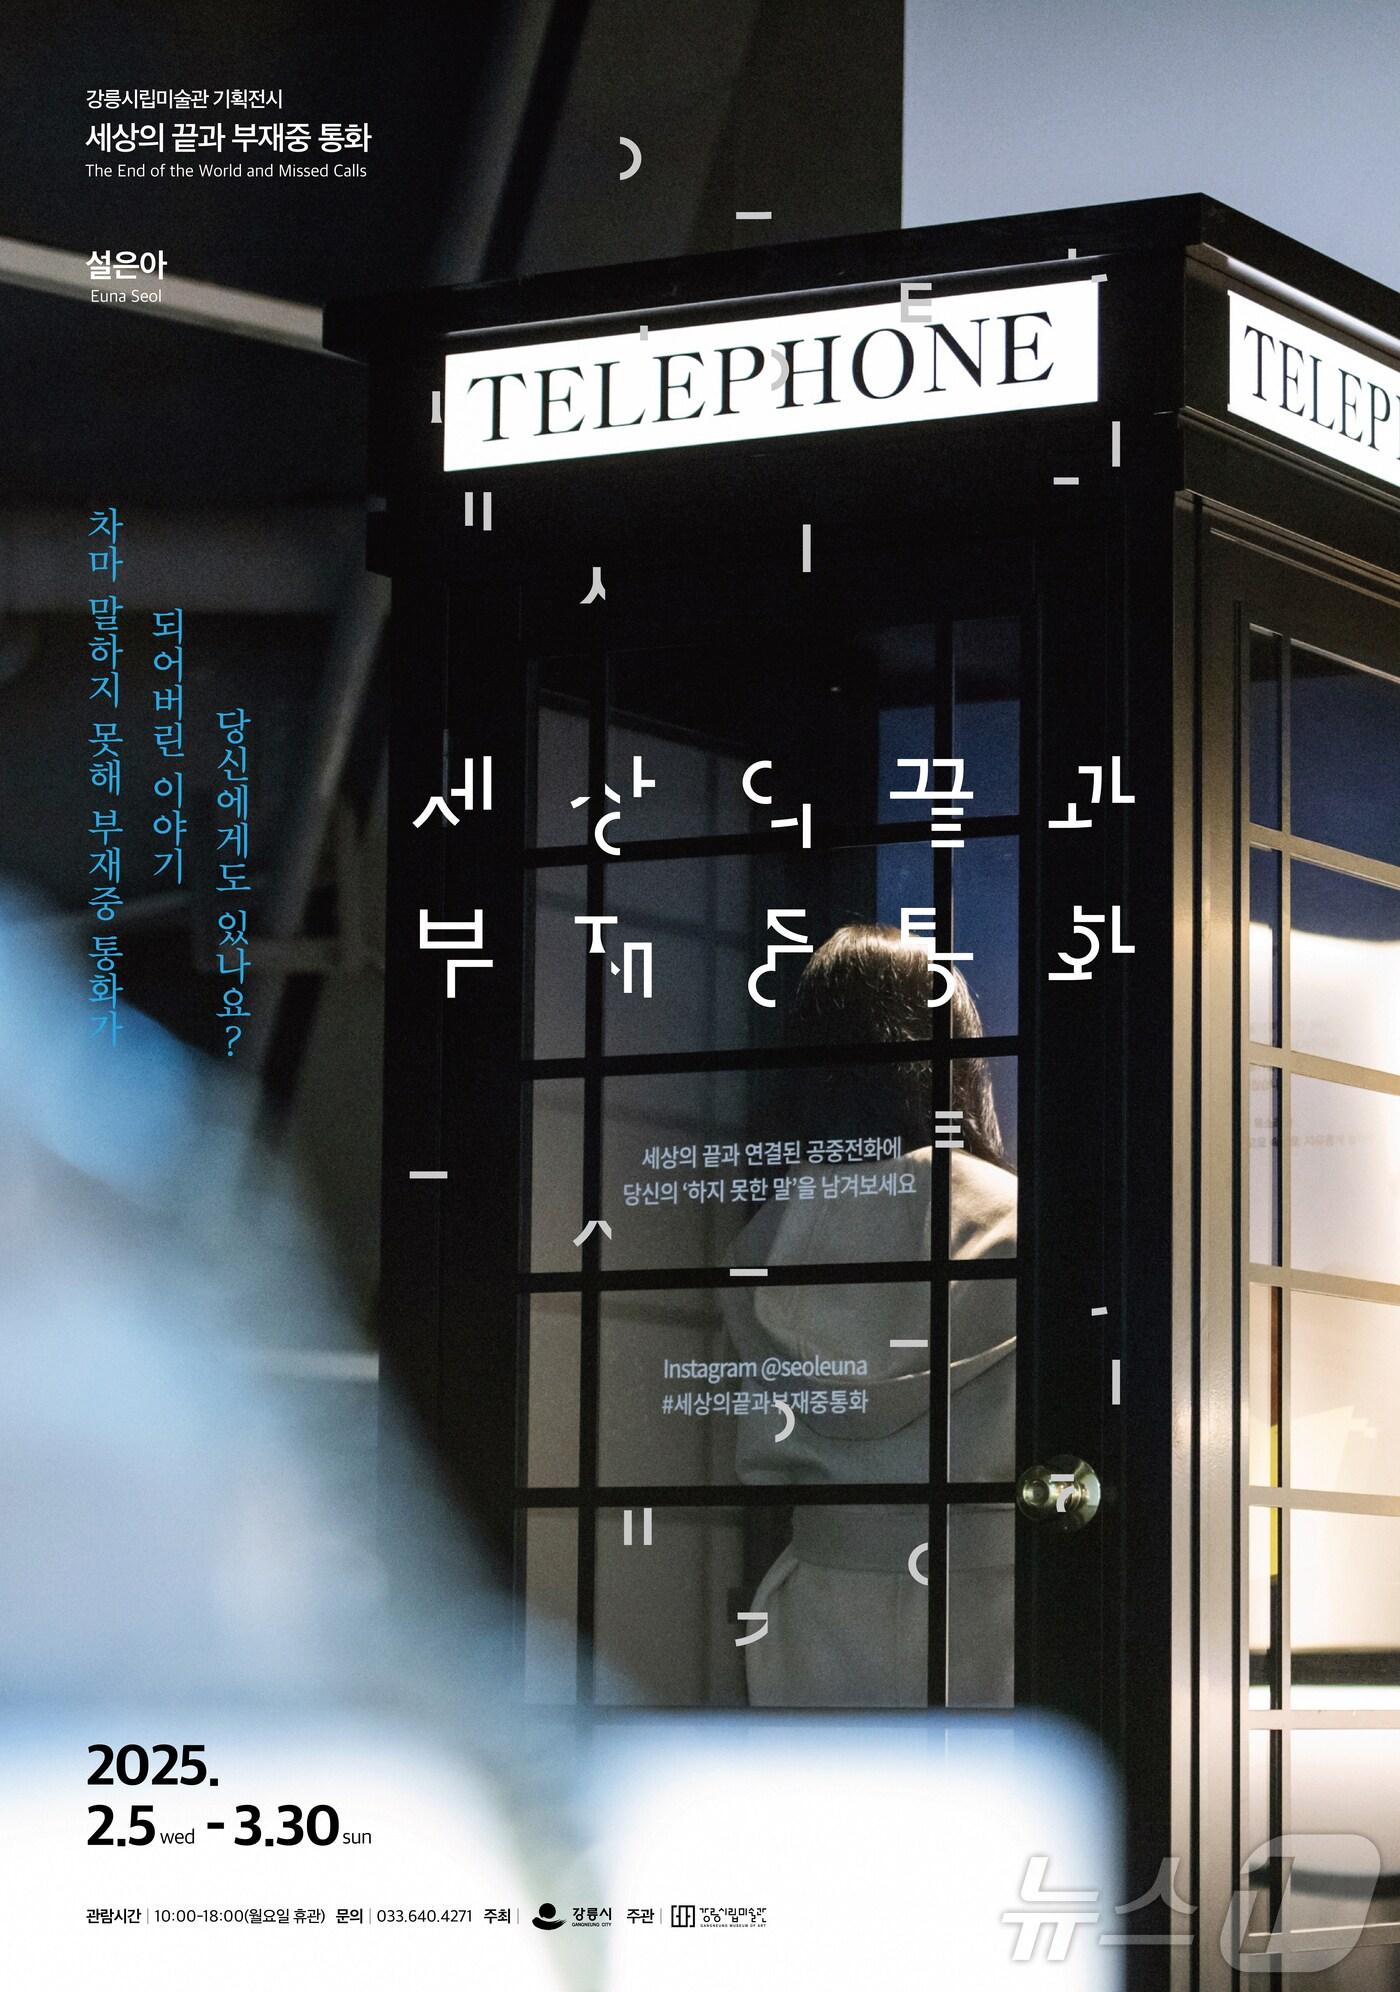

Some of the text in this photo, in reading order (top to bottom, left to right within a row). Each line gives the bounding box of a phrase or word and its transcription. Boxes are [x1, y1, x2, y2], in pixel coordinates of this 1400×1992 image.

[86, 88, 282, 110] 강릉시립미술관 기획전시
[85, 122, 373, 153] 세상의 끝과 부재중 통화
[84, 163, 367, 178] The End of the World and Missed Calls
[85, 250, 167, 280] 설은아
[90, 288, 163, 304] Euna Seol
[464, 309, 1056, 443] TELEPHONE
[1244, 324, 1400, 461] TELEP
[150, 606, 189, 883] 되어버린 이야기
[87, 506, 125, 1048] 차마 말하지 못해 부재중 통화가
[214, 706, 253, 1058] 당신에게도 있나요?
[641, 1135, 902, 1170] 세상의 끝과 연결된 공중전화에
[623, 1181, 679, 1206] 당신의
[730, 1177, 768, 1202] 못한
[822, 1172, 917, 1199] 남겨보세요
[663, 1355, 868, 1384] Instagram @seoleuna
[87, 1743, 219, 1787] 2025.
[87, 1804, 156, 1847] 2.5
[159, 1828, 195, 1845] wed
[234, 1804, 340, 1847] 3.30
[342, 1832, 372, 1845] sun
[86, 1908, 142, 1925] 관람시간
[293, 1908, 326, 1924] 휴관)
[335, 1908, 363, 1924] 문의
[376, 1909, 472, 1923] 033.640.4271
[483, 1908, 511, 1925] 주최
[572, 1907, 612, 1922] 강릉시
[626, 1908, 655, 1925] 주관
[699, 1907, 767, 1923] 강릉시립미술관
